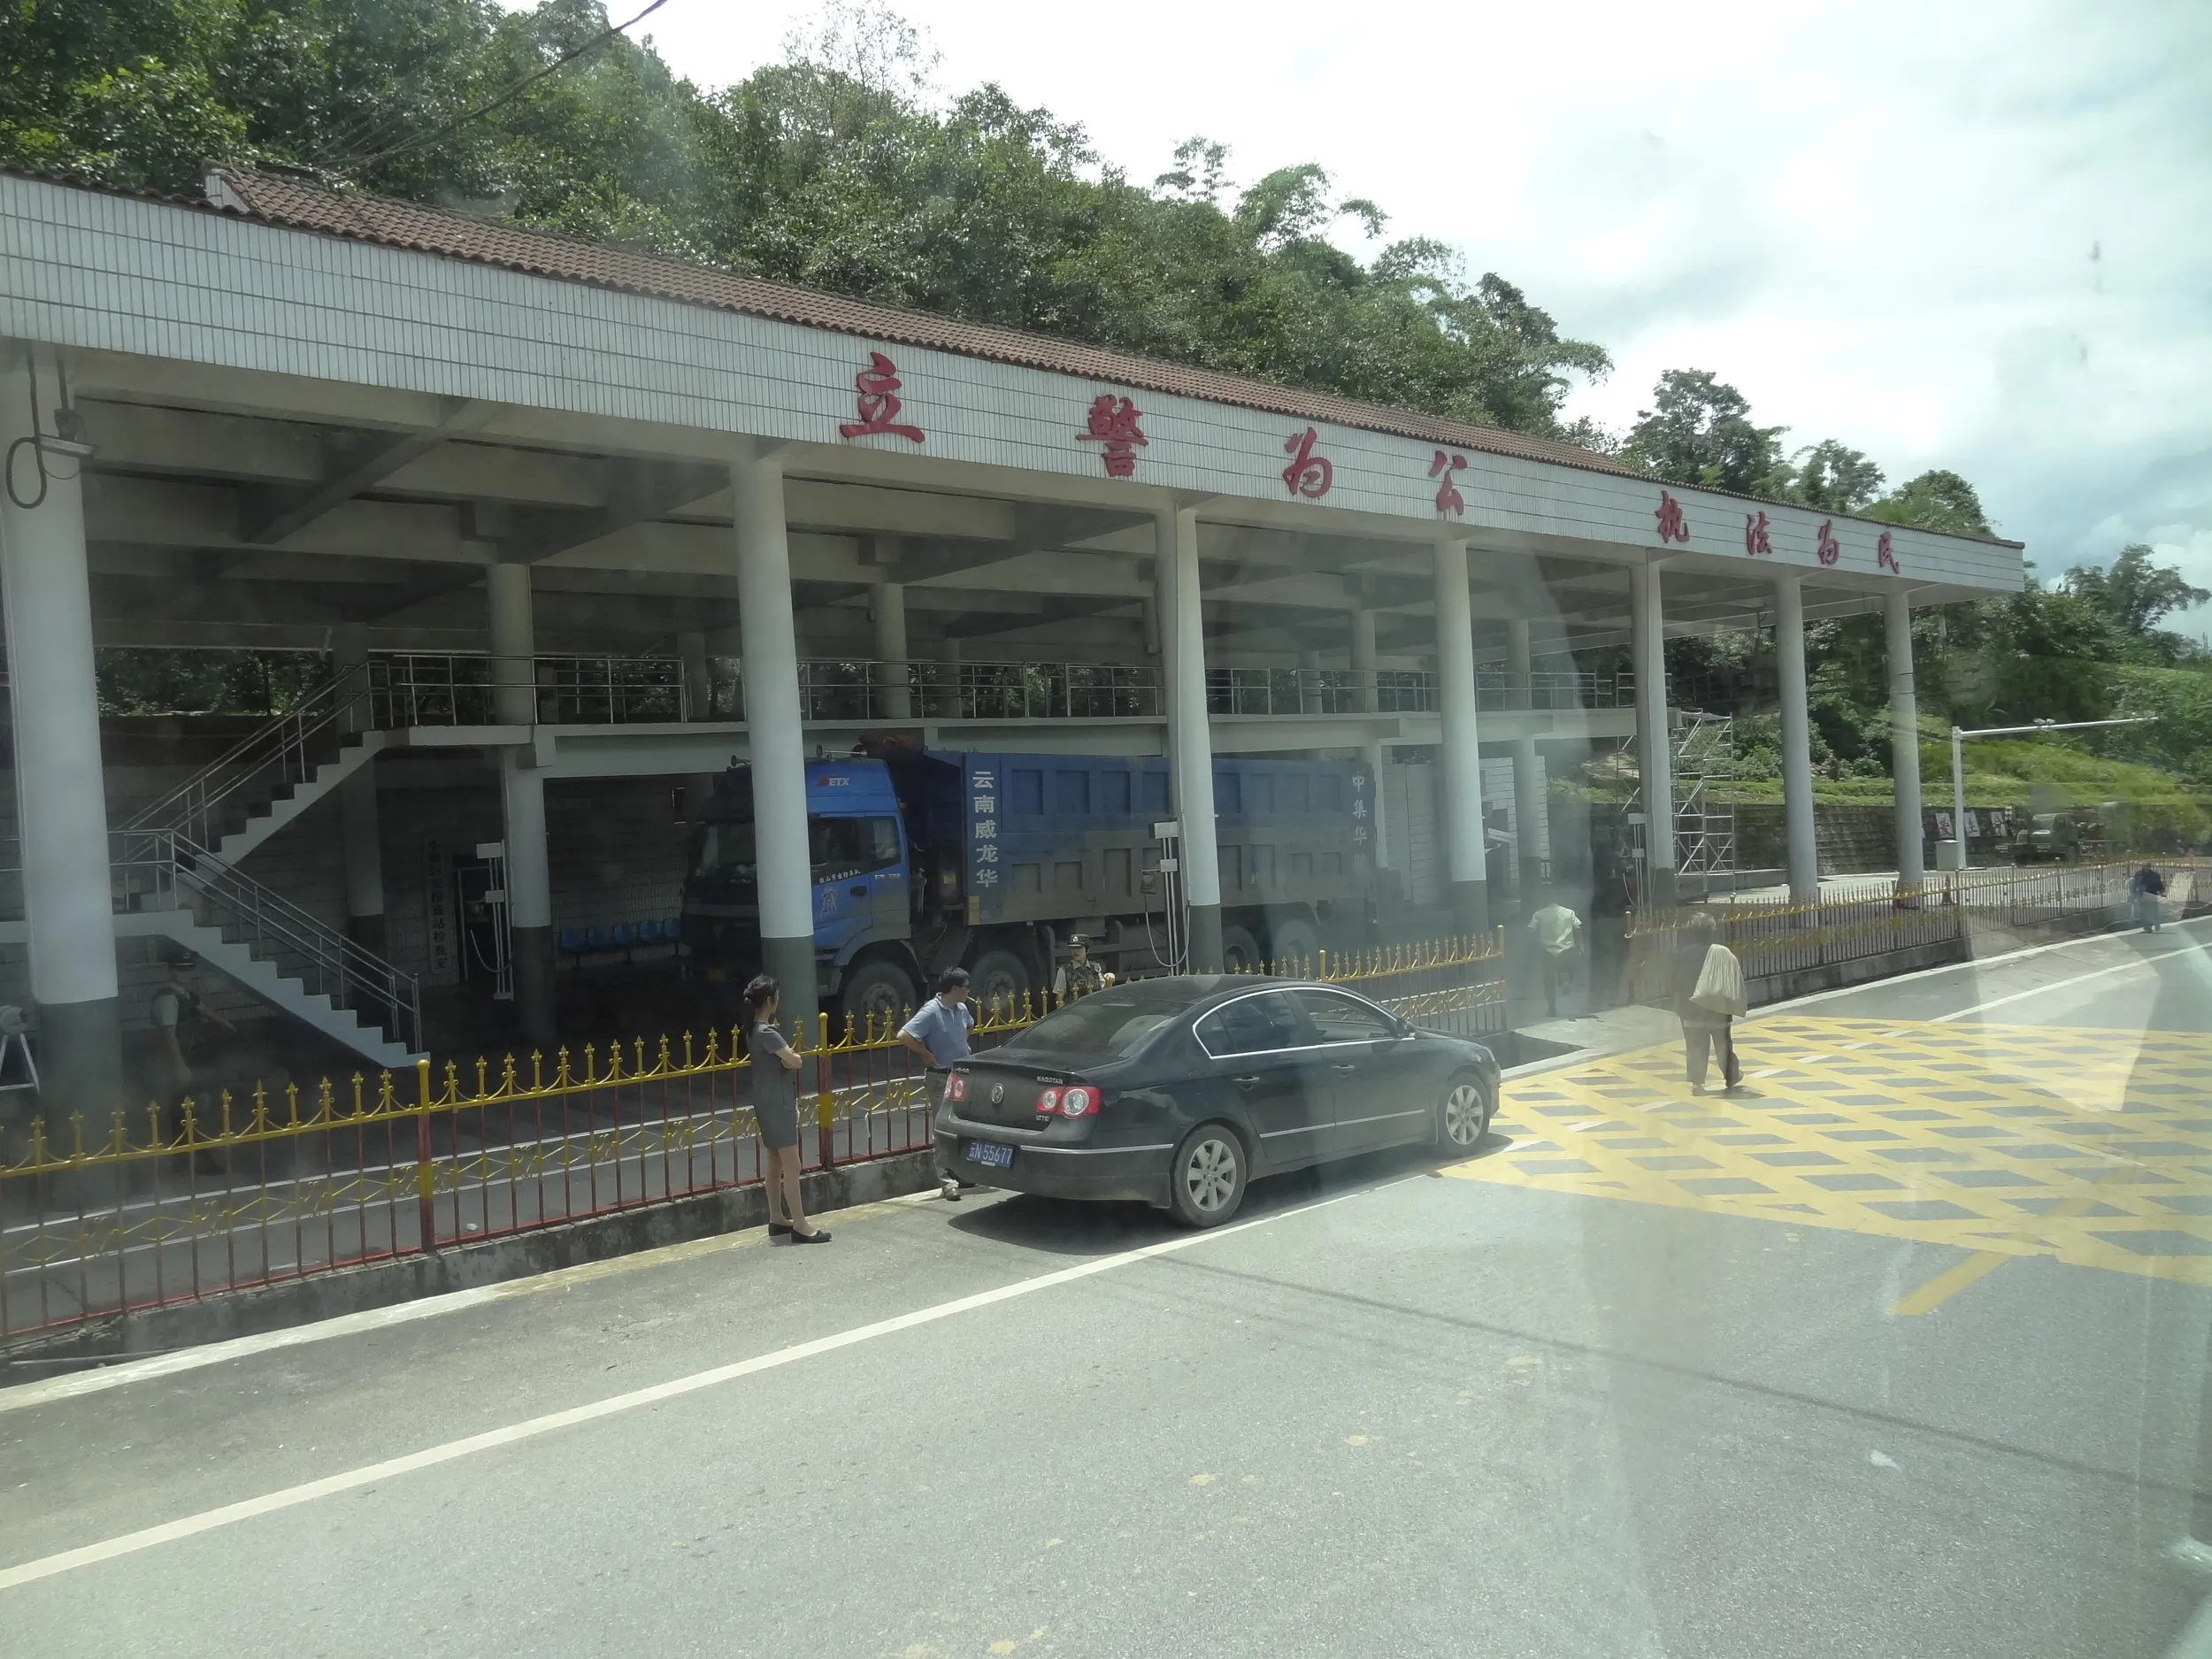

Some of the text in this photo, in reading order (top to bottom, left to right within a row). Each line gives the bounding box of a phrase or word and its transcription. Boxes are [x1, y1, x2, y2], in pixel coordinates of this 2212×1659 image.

[972, 770, 998, 888] 云南威龙华
